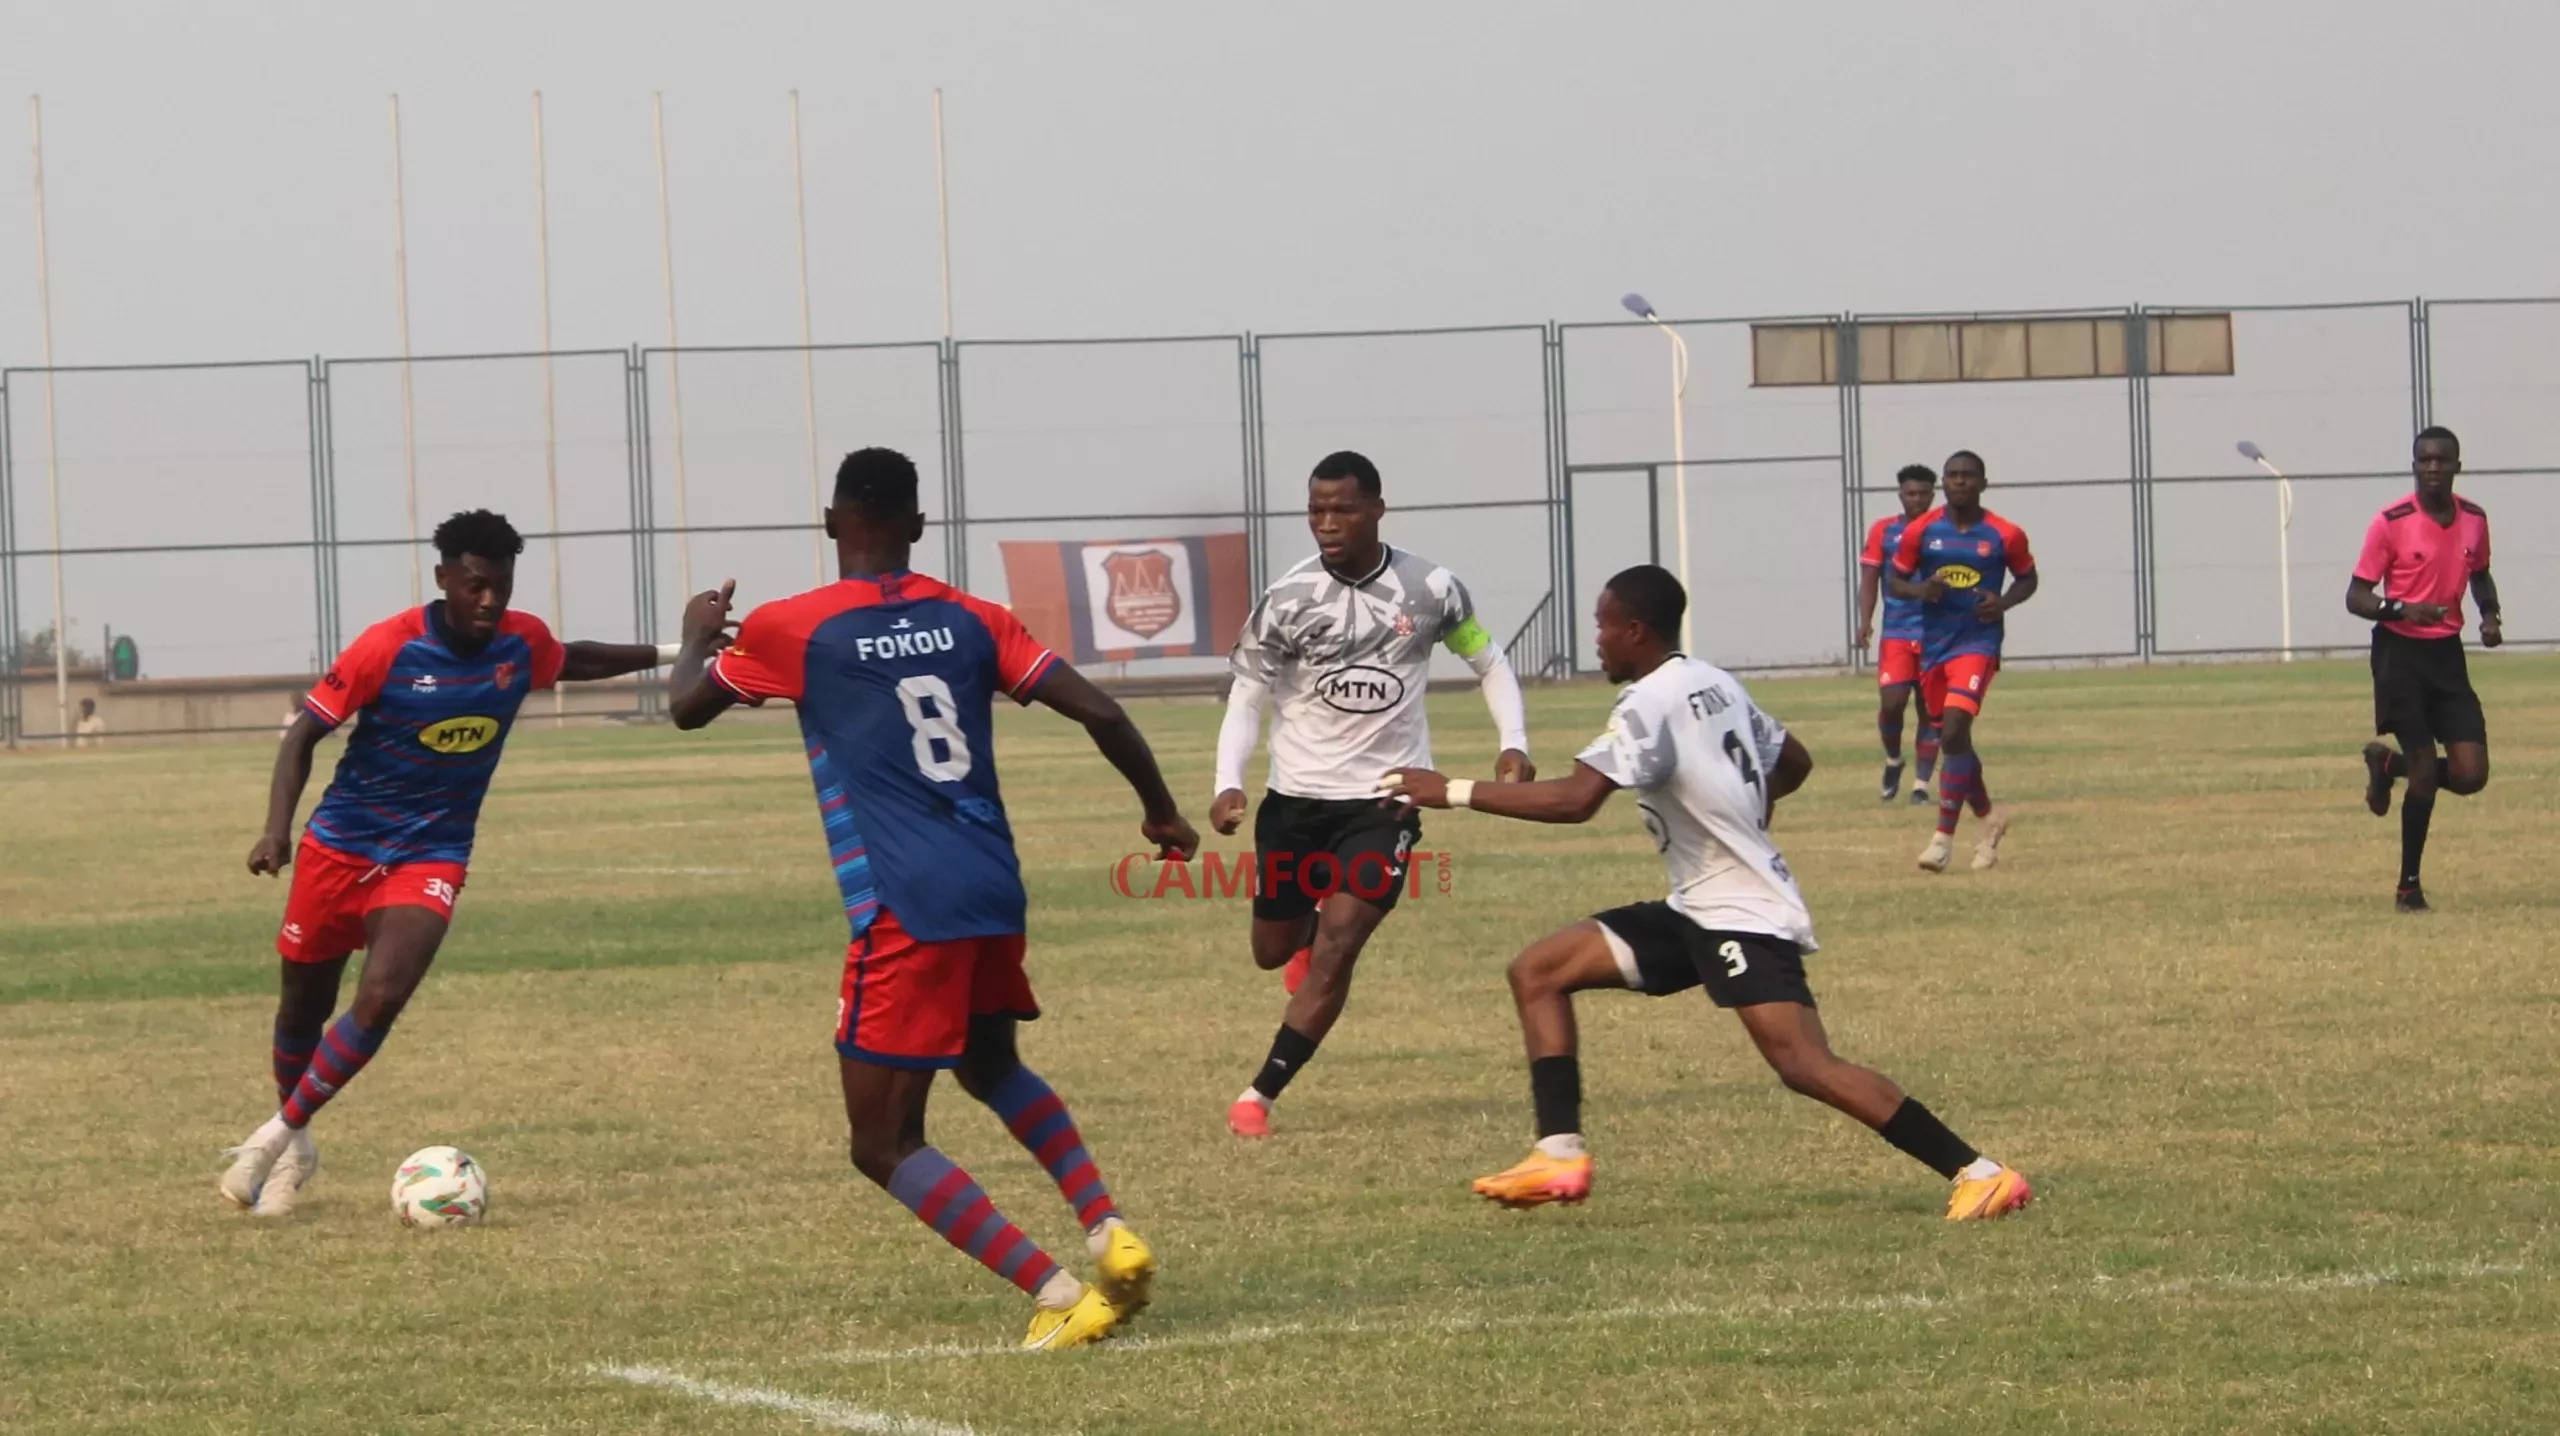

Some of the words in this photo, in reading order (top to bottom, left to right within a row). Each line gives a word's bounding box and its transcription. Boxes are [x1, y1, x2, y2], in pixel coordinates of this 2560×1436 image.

[856, 627, 955, 661] FOKOU
[1330, 680, 1387, 700] MTN
[436, 725, 486, 745] MTN
[895, 674, 972, 783] 8
[1718, 939, 1749, 978] 3
